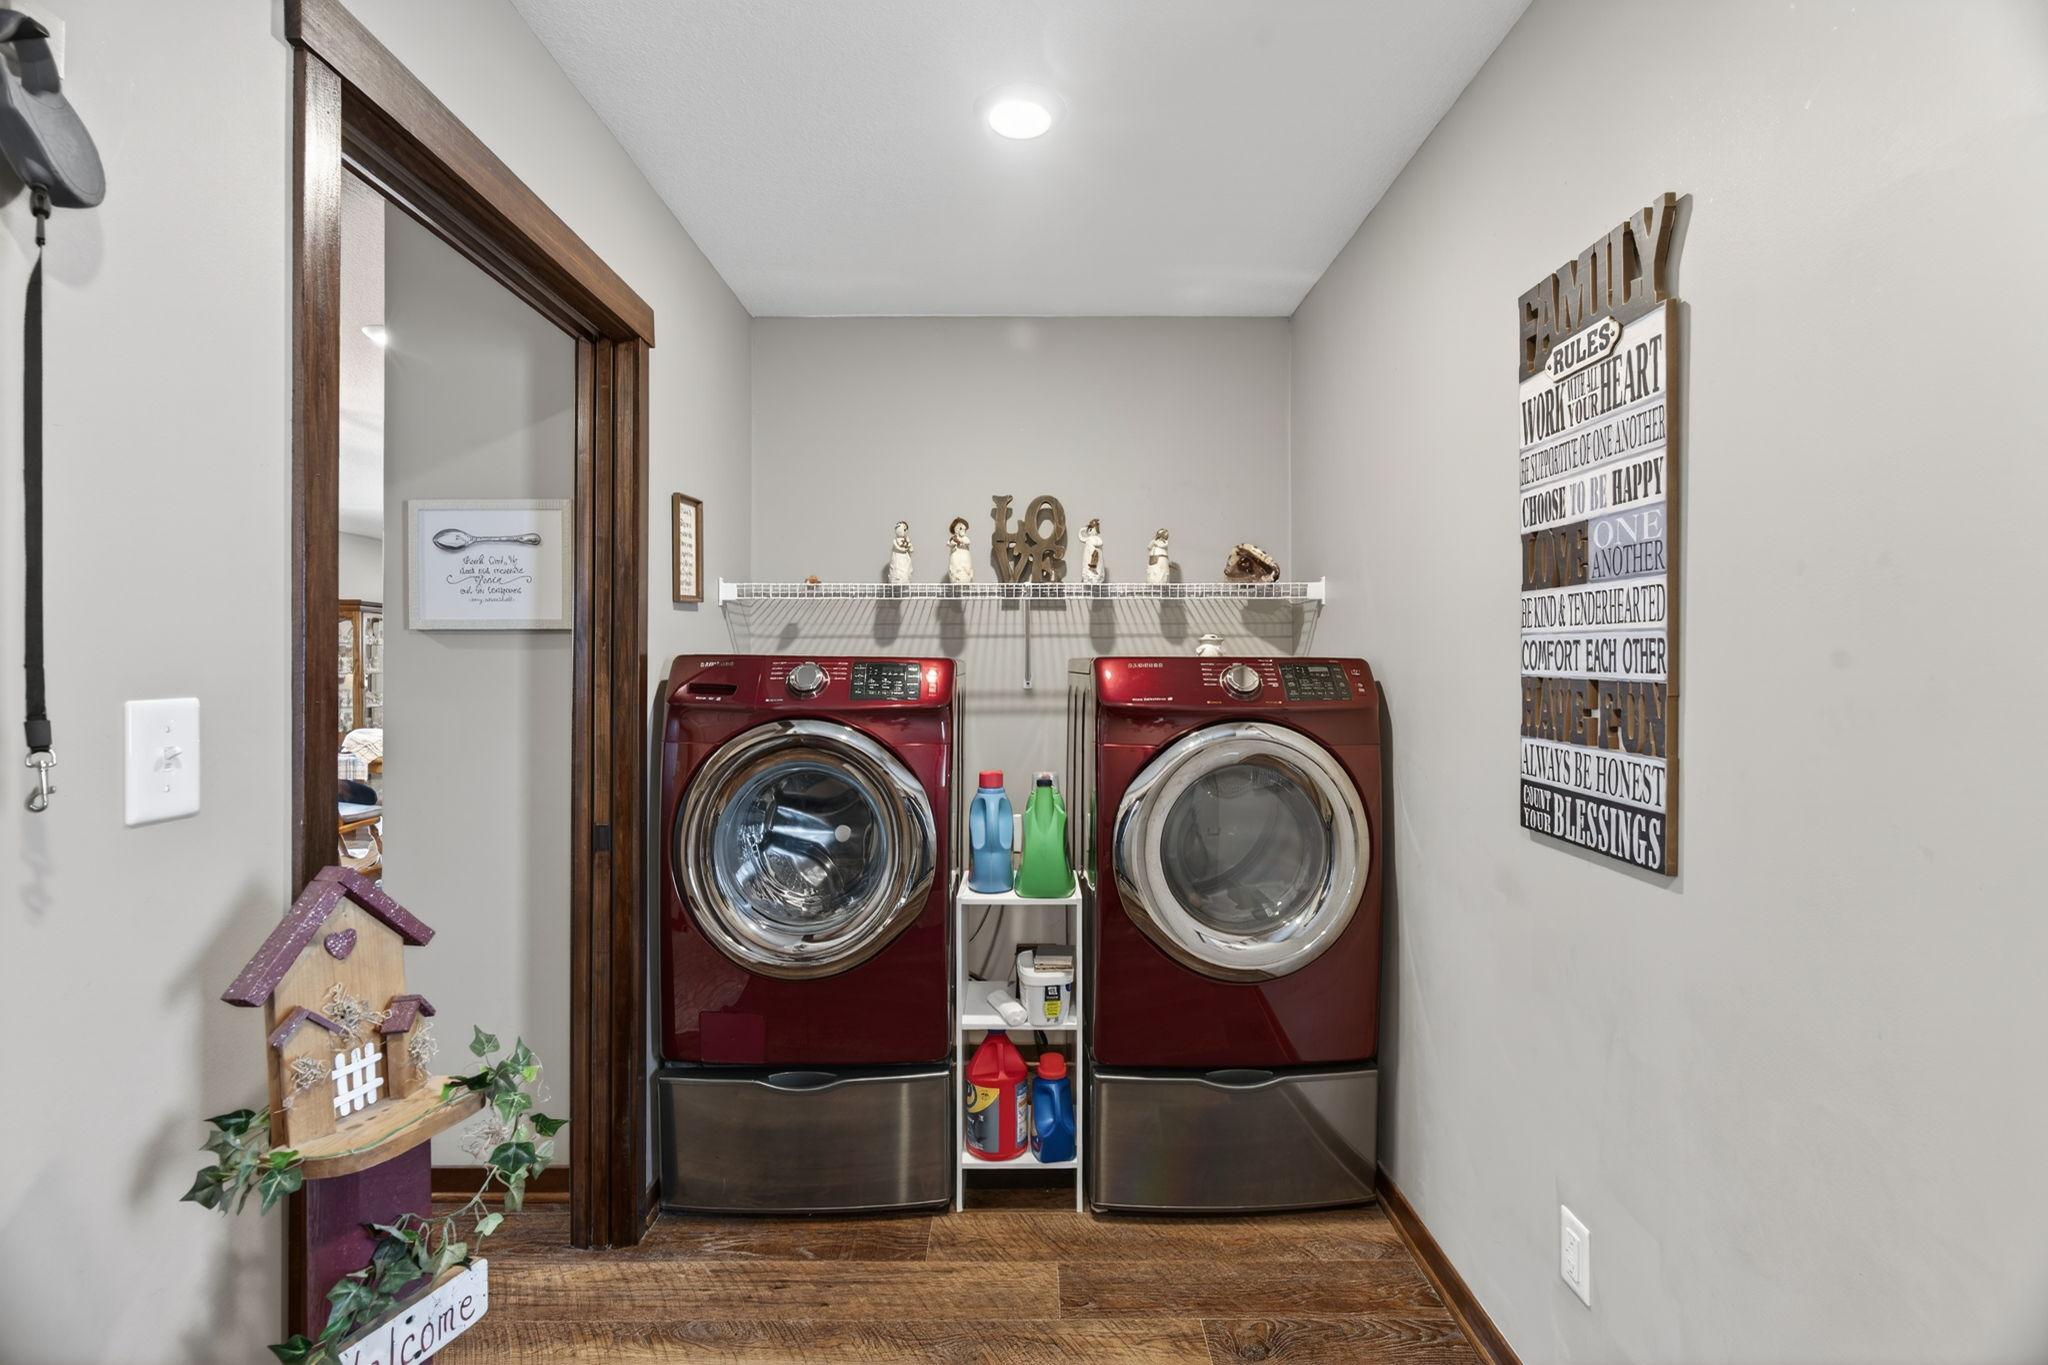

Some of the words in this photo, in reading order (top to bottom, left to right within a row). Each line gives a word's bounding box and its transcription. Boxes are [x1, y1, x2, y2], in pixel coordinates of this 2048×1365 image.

[1517, 192, 1676, 380] FAMILY
[1553, 322, 1611, 375] RULES
[1600, 334, 1662, 414] HEART
[1567, 372, 1585, 401] WITH
[1587, 366, 1599, 393] ALL
[1522, 382, 1566, 445] WORK
[1568, 393, 1599, 427] YOUR
[1520, 457, 1529, 486] BE
[1531, 438, 1578, 483] SUPPORTIVE
[1580, 433, 1591, 466] OF
[1593, 424, 1613, 461] ONE
[1614, 404, 1665, 454] ANOTHER
[1522, 486, 1566, 528] CHOOSE
[1569, 480, 1585, 516] TO
[1590, 474, 1607, 511] BE
[1612, 456, 1664, 506] HAPPY
[1521, 520, 1588, 592] LOVE
[1593, 508, 1663, 549] ONE
[1591, 539, 1666, 579] ANOTHER
[1521, 598, 1532, 628] BE
[1534, 595, 1557, 628] KIND
[1559, 593, 1565, 627] &
[1568, 584, 1666, 626] TENDERHEARTED
[1522, 639, 1580, 671] COMFORT
[1586, 638, 1617, 673] EACH
[1623, 637, 1666, 674] OTHER
[1521, 743, 1571, 786] ALWAYS
[1574, 751, 1592, 790] BE
[1596, 756, 1665, 807] HONEST
[1523, 784, 1551, 812] COUNT
[1524, 807, 1551, 833] YOUR
[1553, 792, 1661, 869] BLESSINGS
[354, 1295, 476, 1365] lcome
